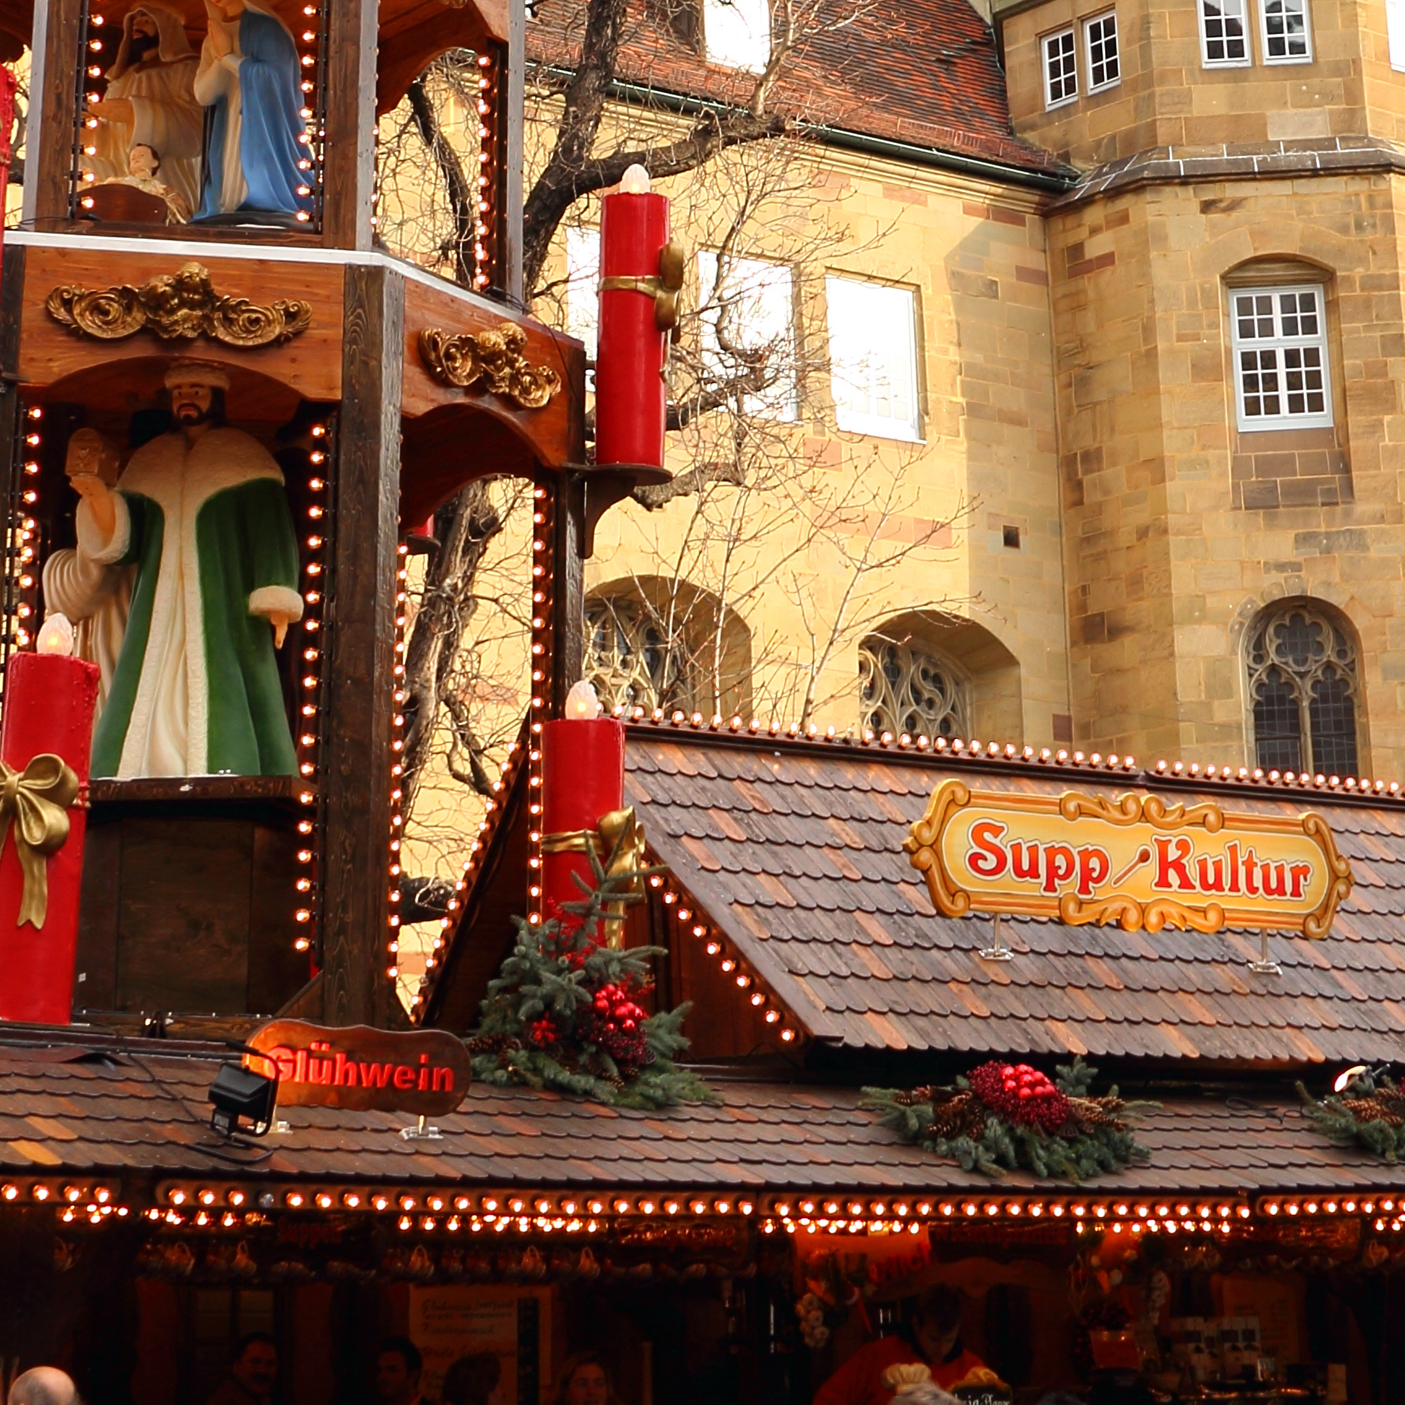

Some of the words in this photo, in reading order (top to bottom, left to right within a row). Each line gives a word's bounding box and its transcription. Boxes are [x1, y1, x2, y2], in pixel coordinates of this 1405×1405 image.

[968, 820, 1110, 896] Supp
[1152, 835, 1311, 899] Kultur
[264, 1041, 454, 1092] Glühwein
